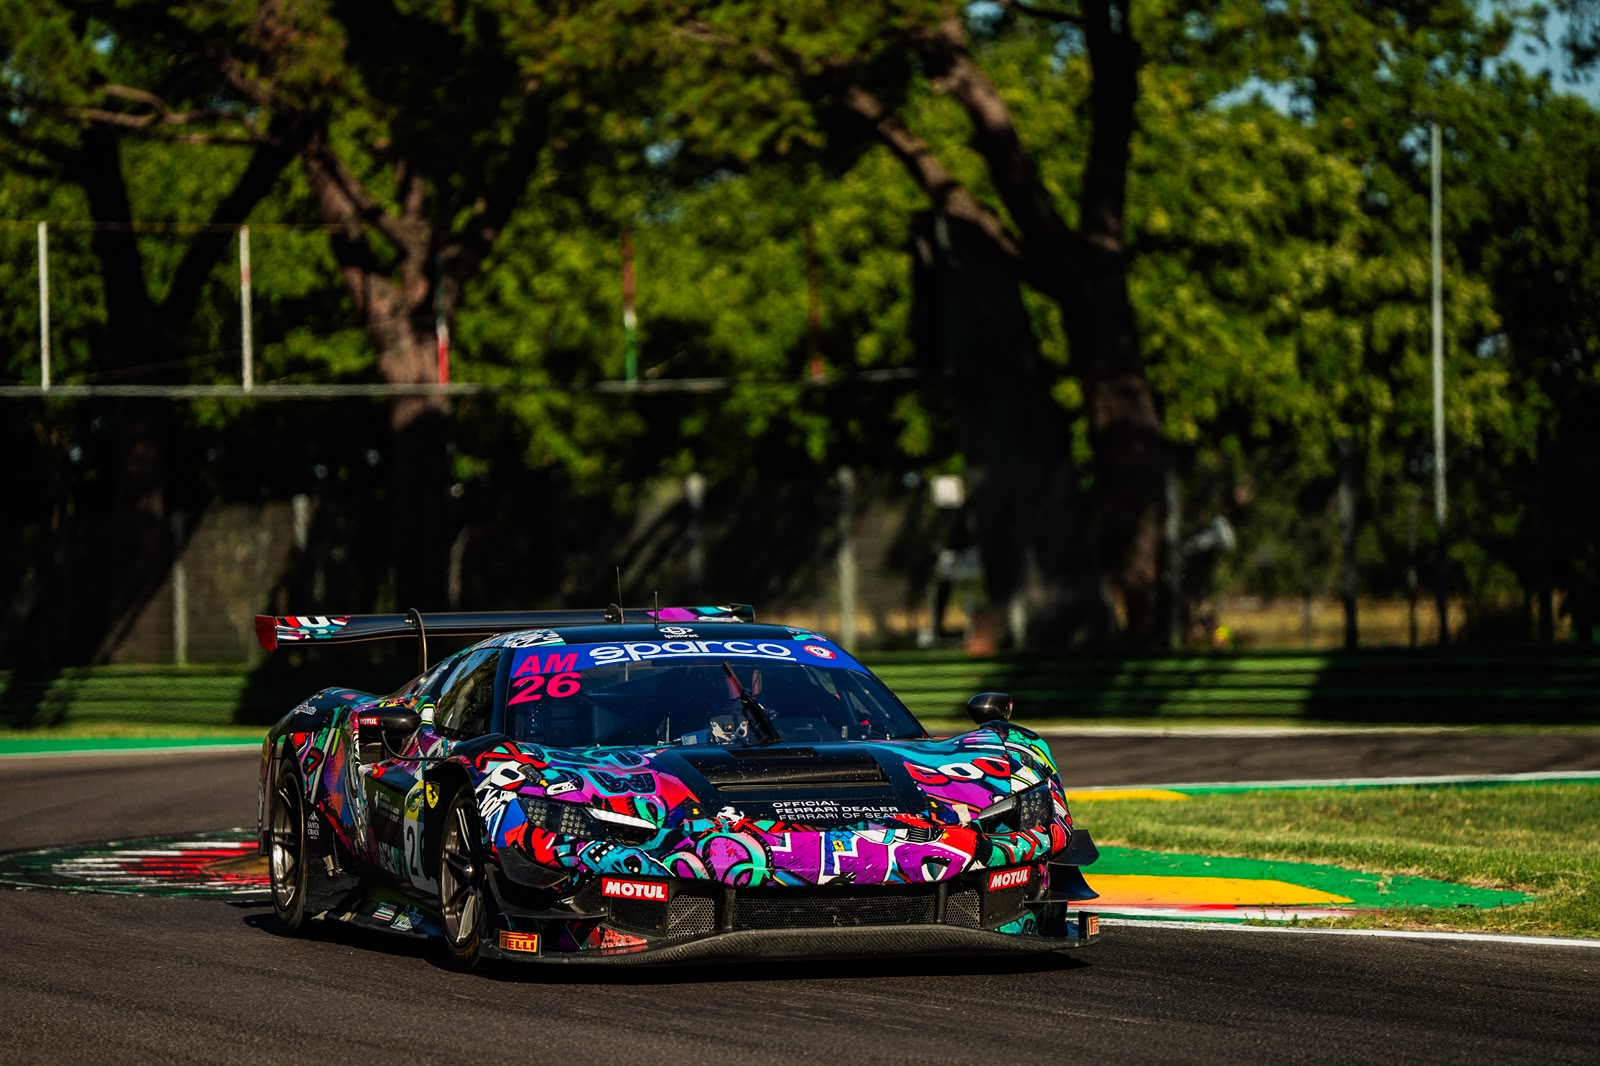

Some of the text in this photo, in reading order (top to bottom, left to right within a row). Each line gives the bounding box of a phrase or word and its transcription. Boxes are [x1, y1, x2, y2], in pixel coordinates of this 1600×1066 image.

[589, 641, 792, 662] sparco
[513, 653, 579, 677] AM
[507, 672, 582, 706] 26
[772, 800, 840, 808] OFFICIAL
[775, 806, 838, 815] FERRARI
[778, 812, 839, 821] FERRARI
[864, 812, 925, 820] SEATTLE
[990, 868, 1029, 889] MOTUL
[605, 881, 665, 899] MOTUL
